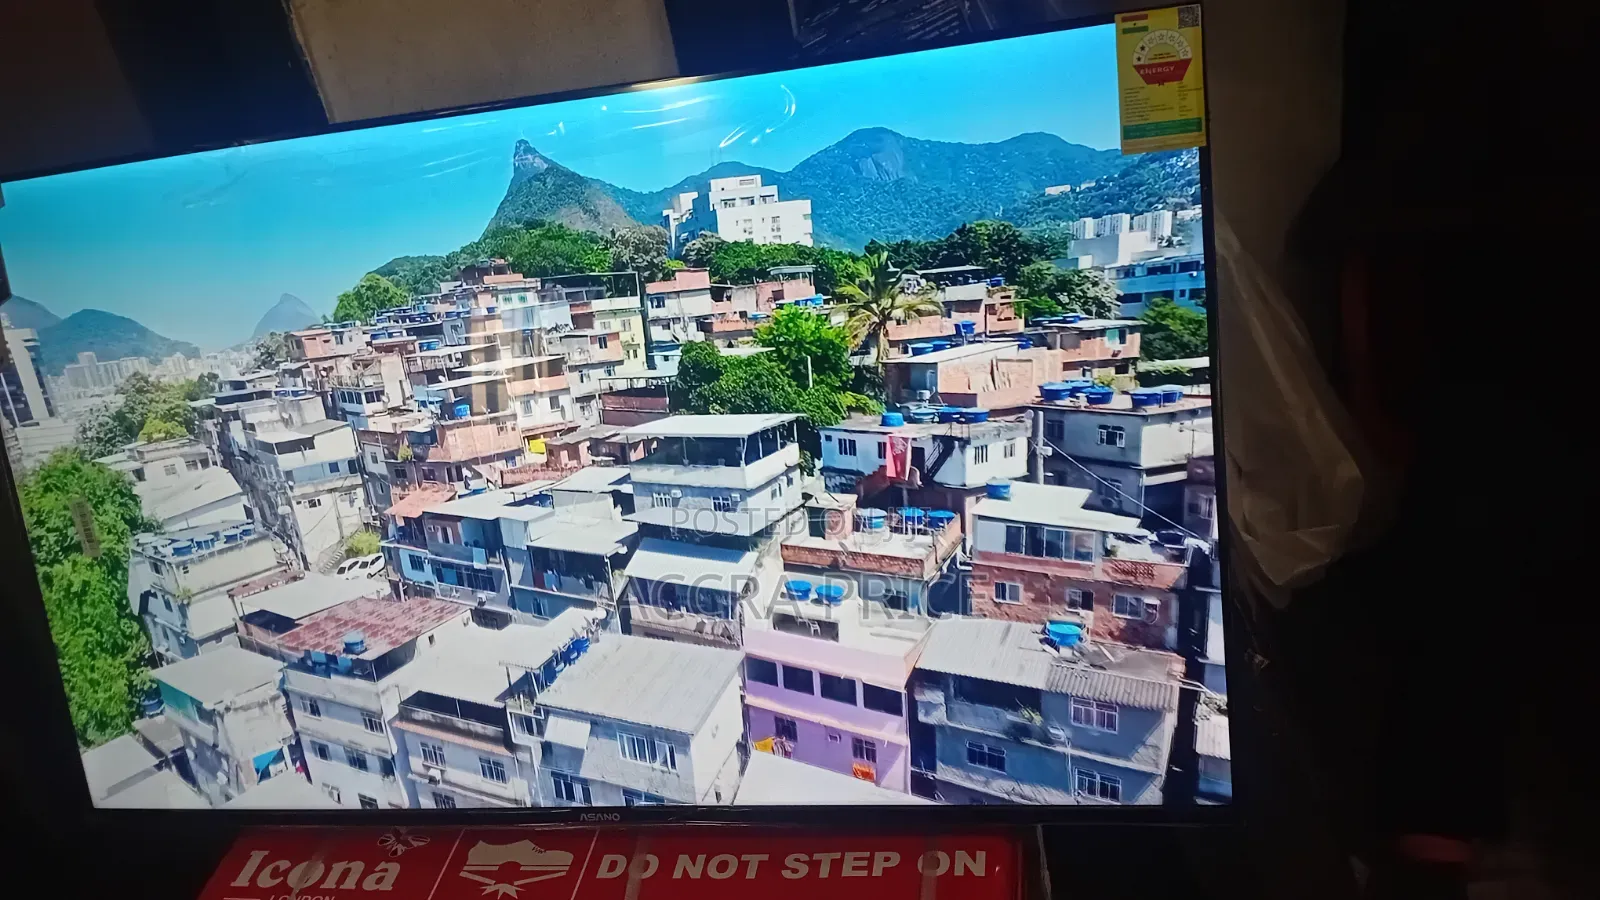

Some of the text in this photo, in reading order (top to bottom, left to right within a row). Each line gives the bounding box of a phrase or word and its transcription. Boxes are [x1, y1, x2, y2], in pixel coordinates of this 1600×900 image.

[1139, 65, 1175, 76] ENERGY
[579, 812, 621, 823] ASANO
[231, 850, 401, 892] Icona
[596, 850, 989, 880] DO NOT STEP ON
